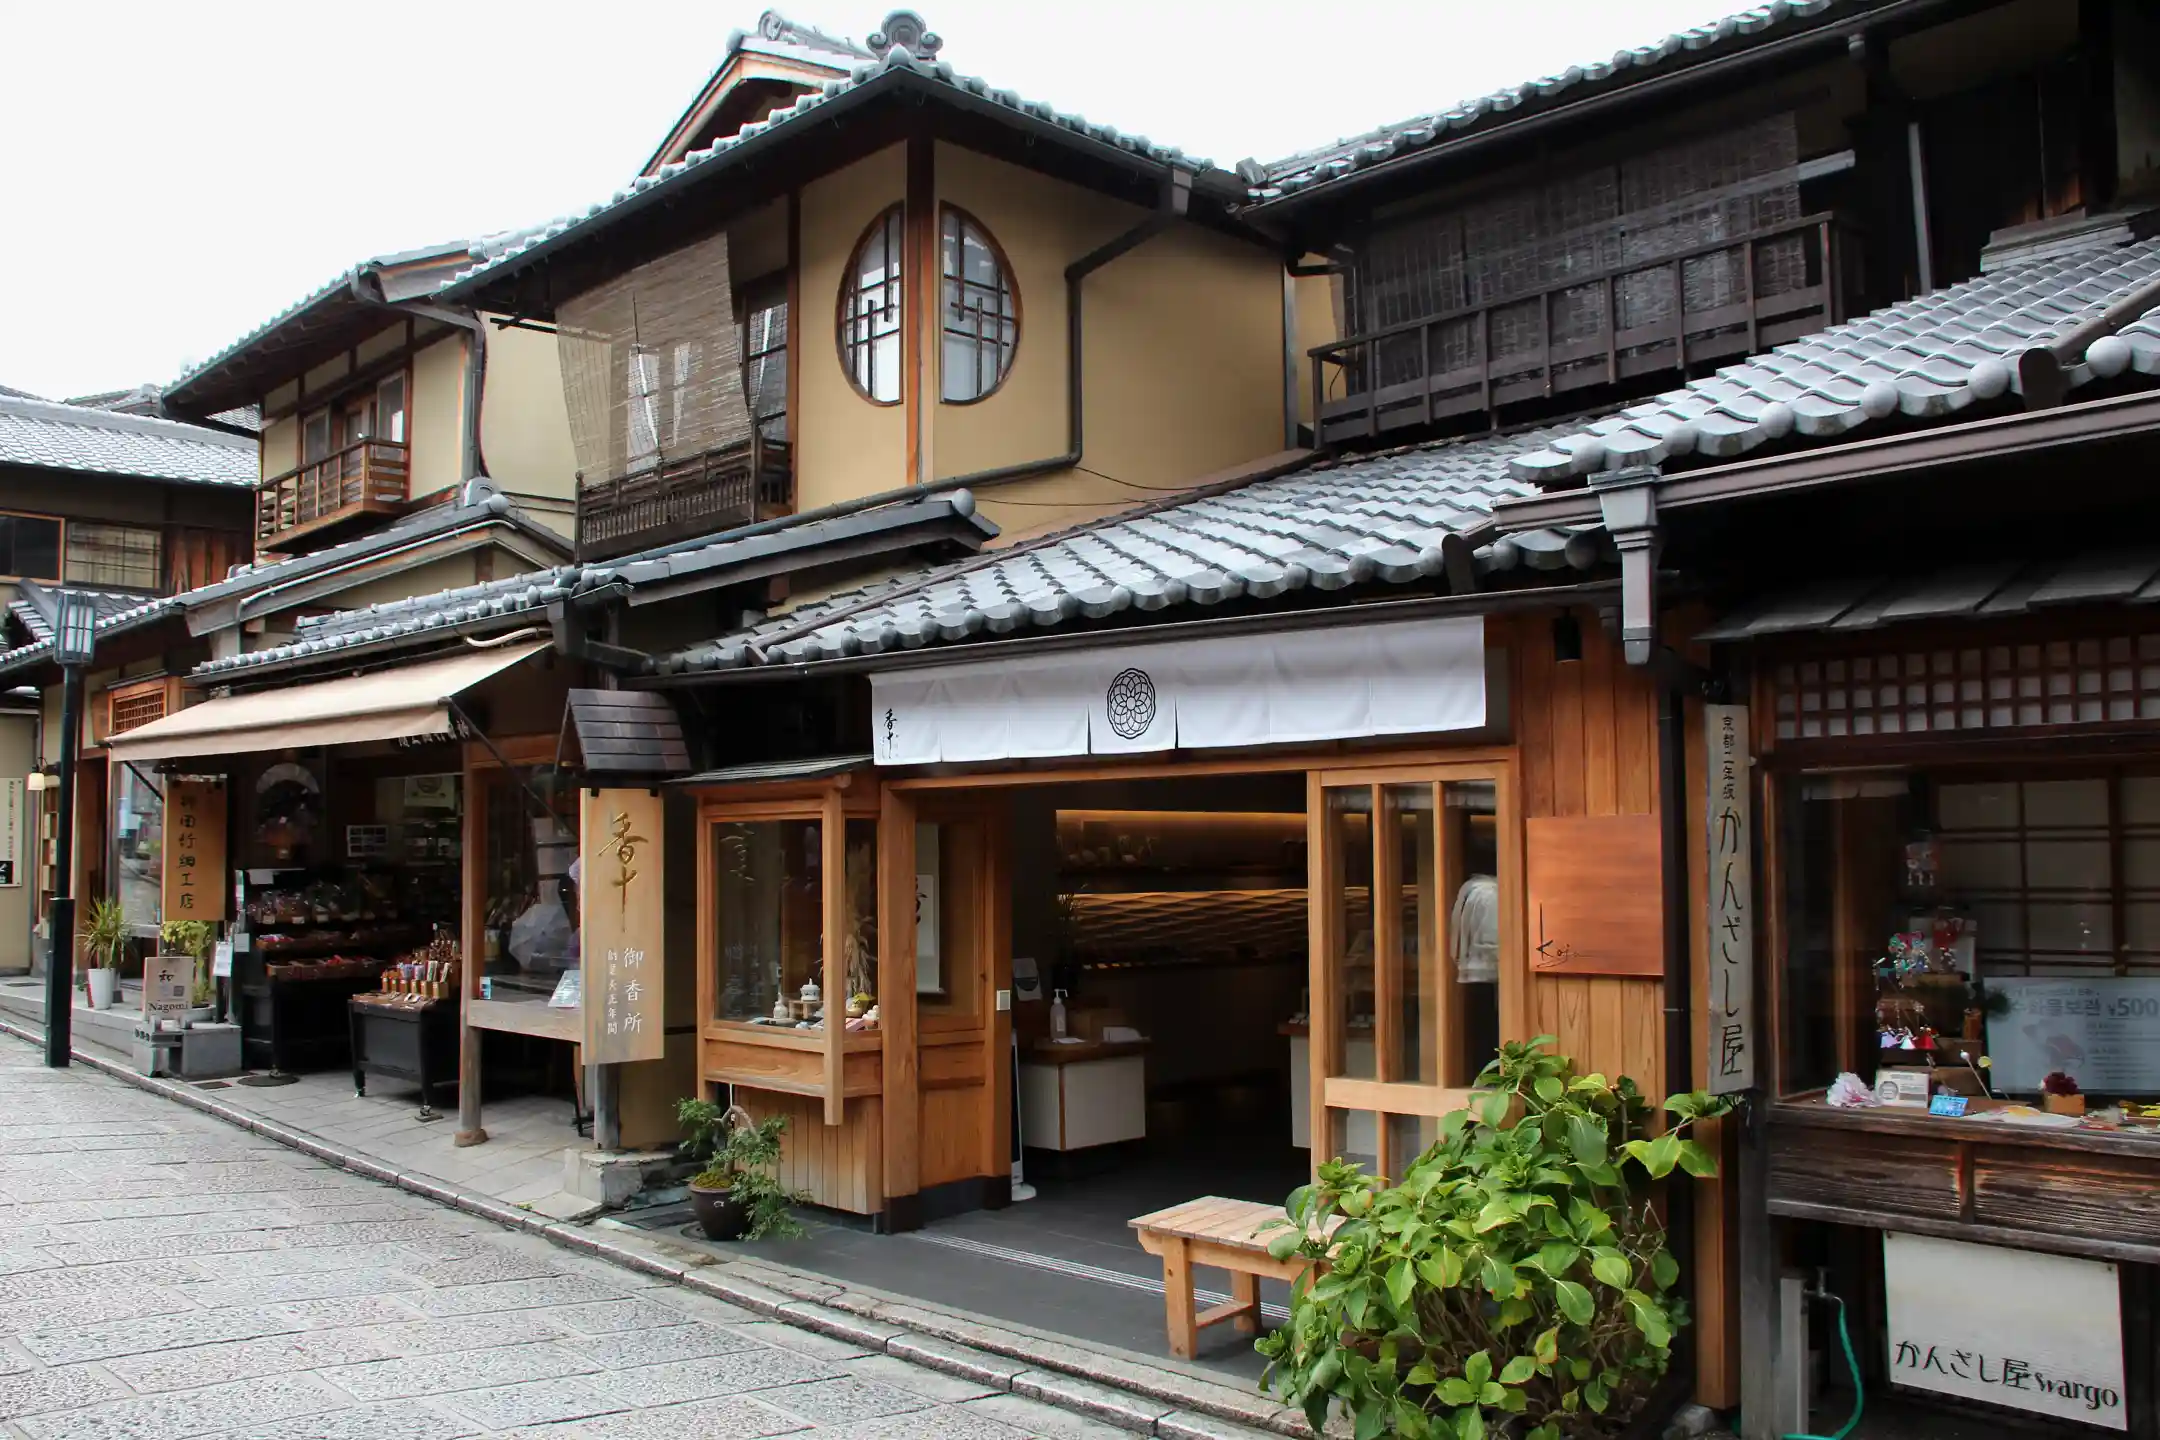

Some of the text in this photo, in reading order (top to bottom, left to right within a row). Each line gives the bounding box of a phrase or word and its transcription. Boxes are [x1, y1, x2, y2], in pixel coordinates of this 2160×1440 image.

[1720, 806, 1744, 1077] かんざし屋
[147, 1000, 188, 1014] Nagomi
[622, 947, 645, 1034] 御香所
